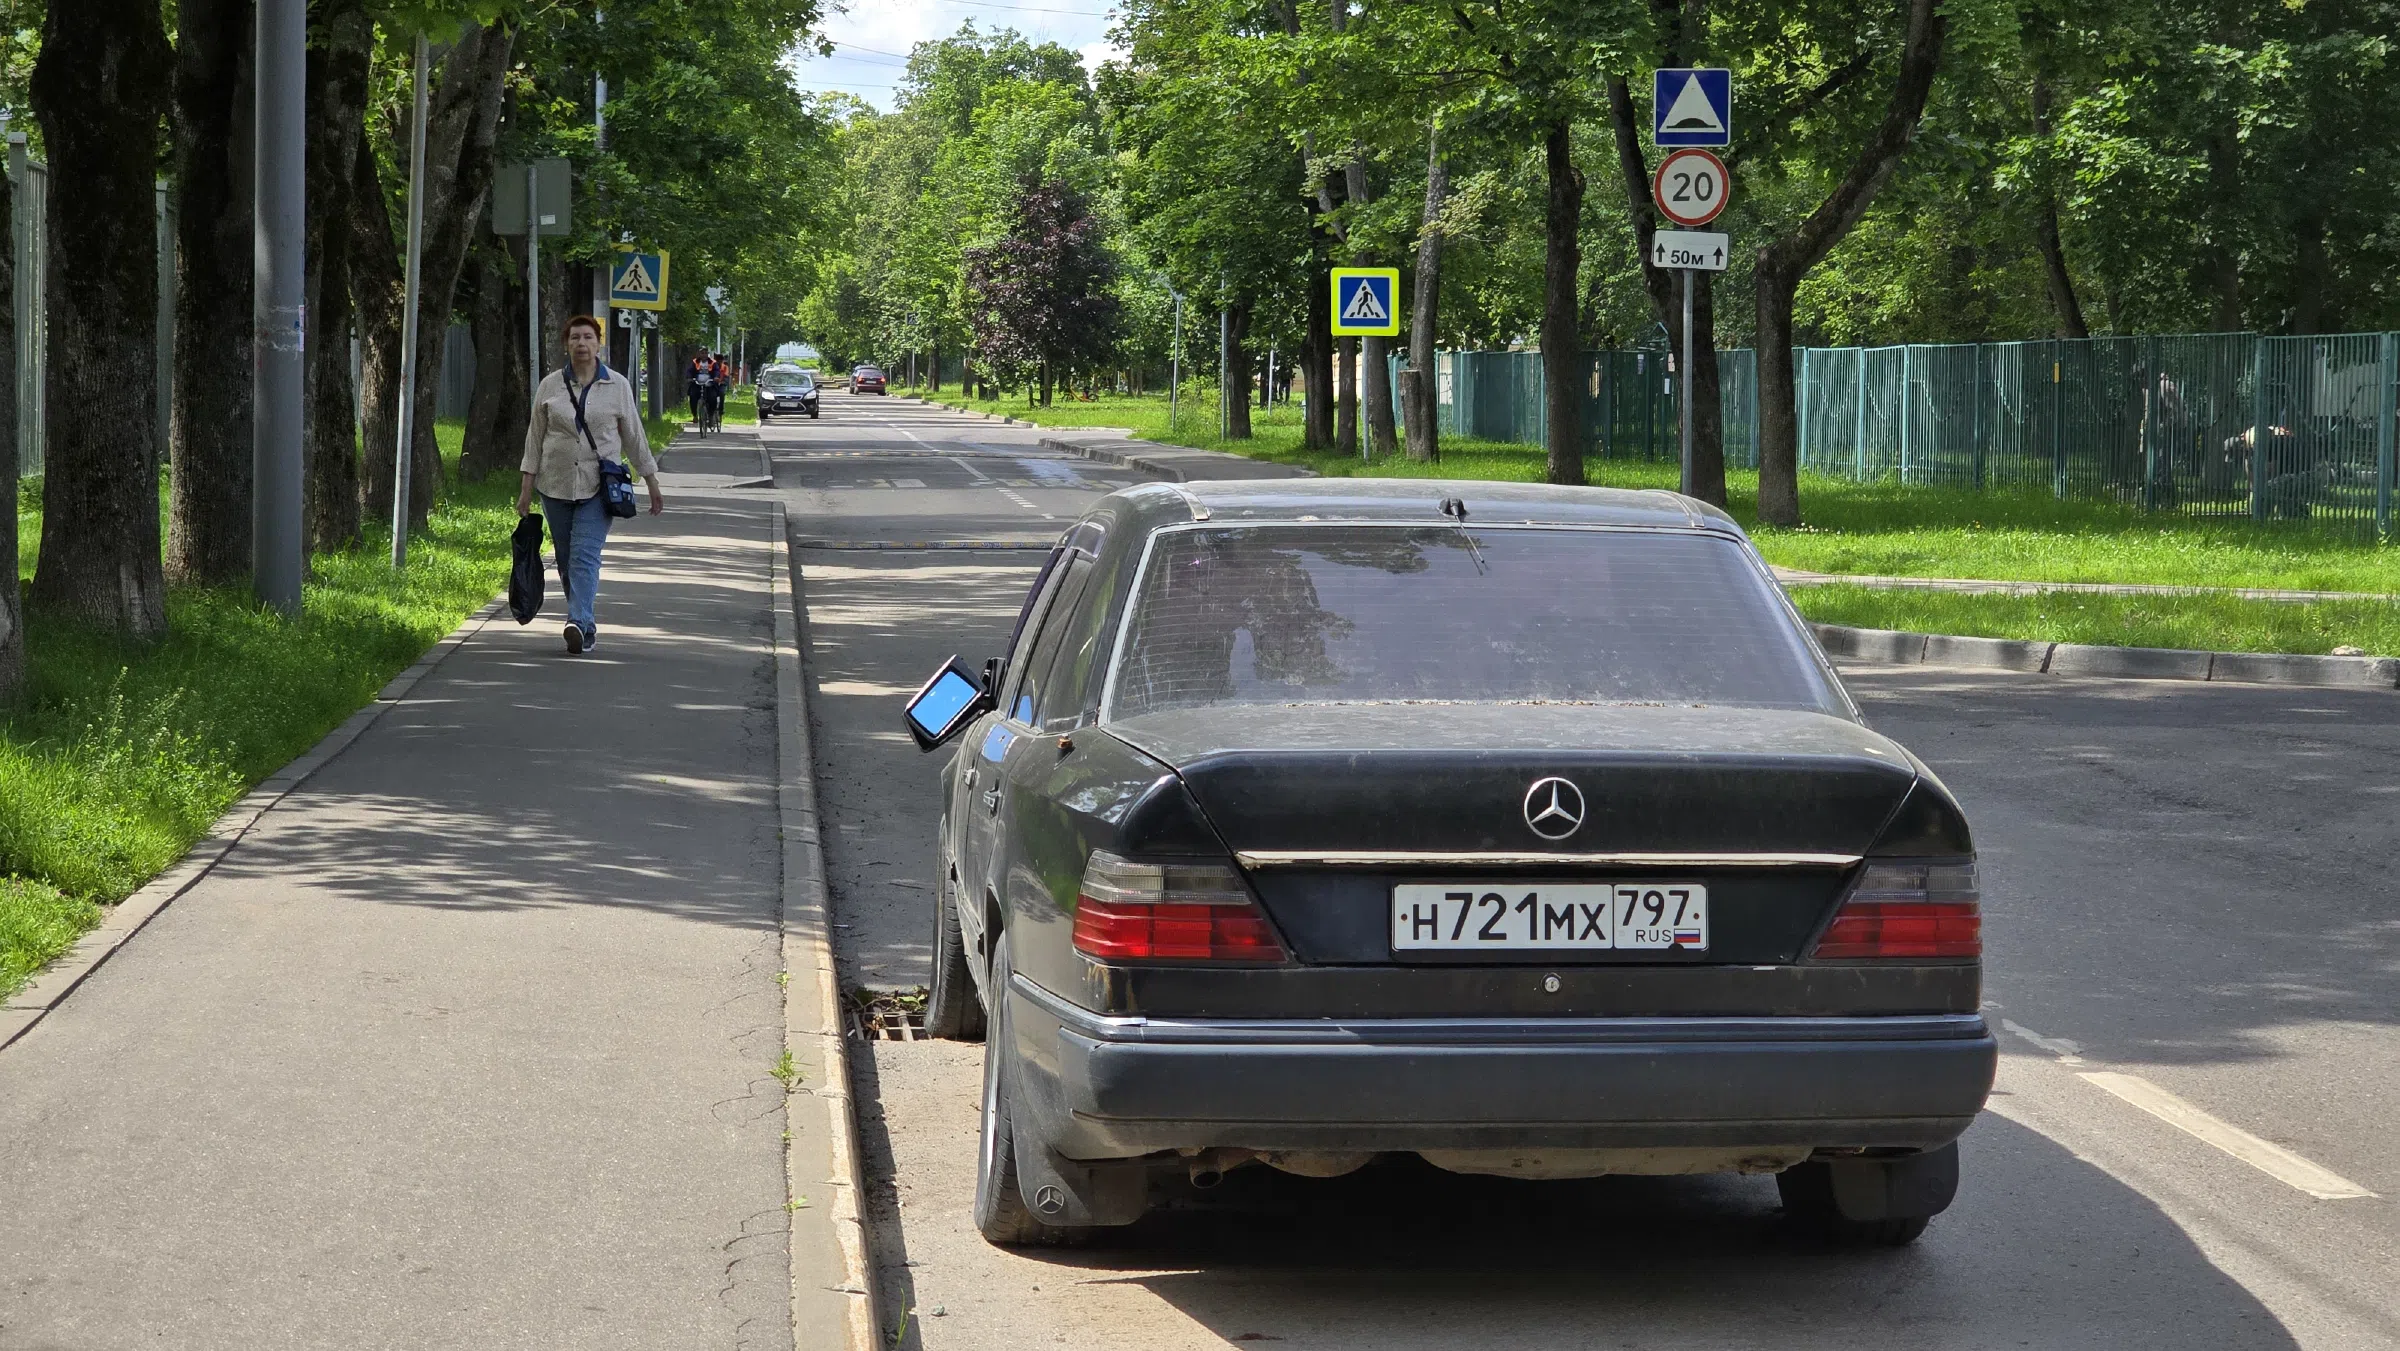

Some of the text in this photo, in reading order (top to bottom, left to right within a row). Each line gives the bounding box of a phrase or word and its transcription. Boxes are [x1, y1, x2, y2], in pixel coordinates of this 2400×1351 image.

[1672, 171, 1714, 202] 20
[1617, 889, 1690, 927] 797
[1635, 929, 1672, 943] RUS
